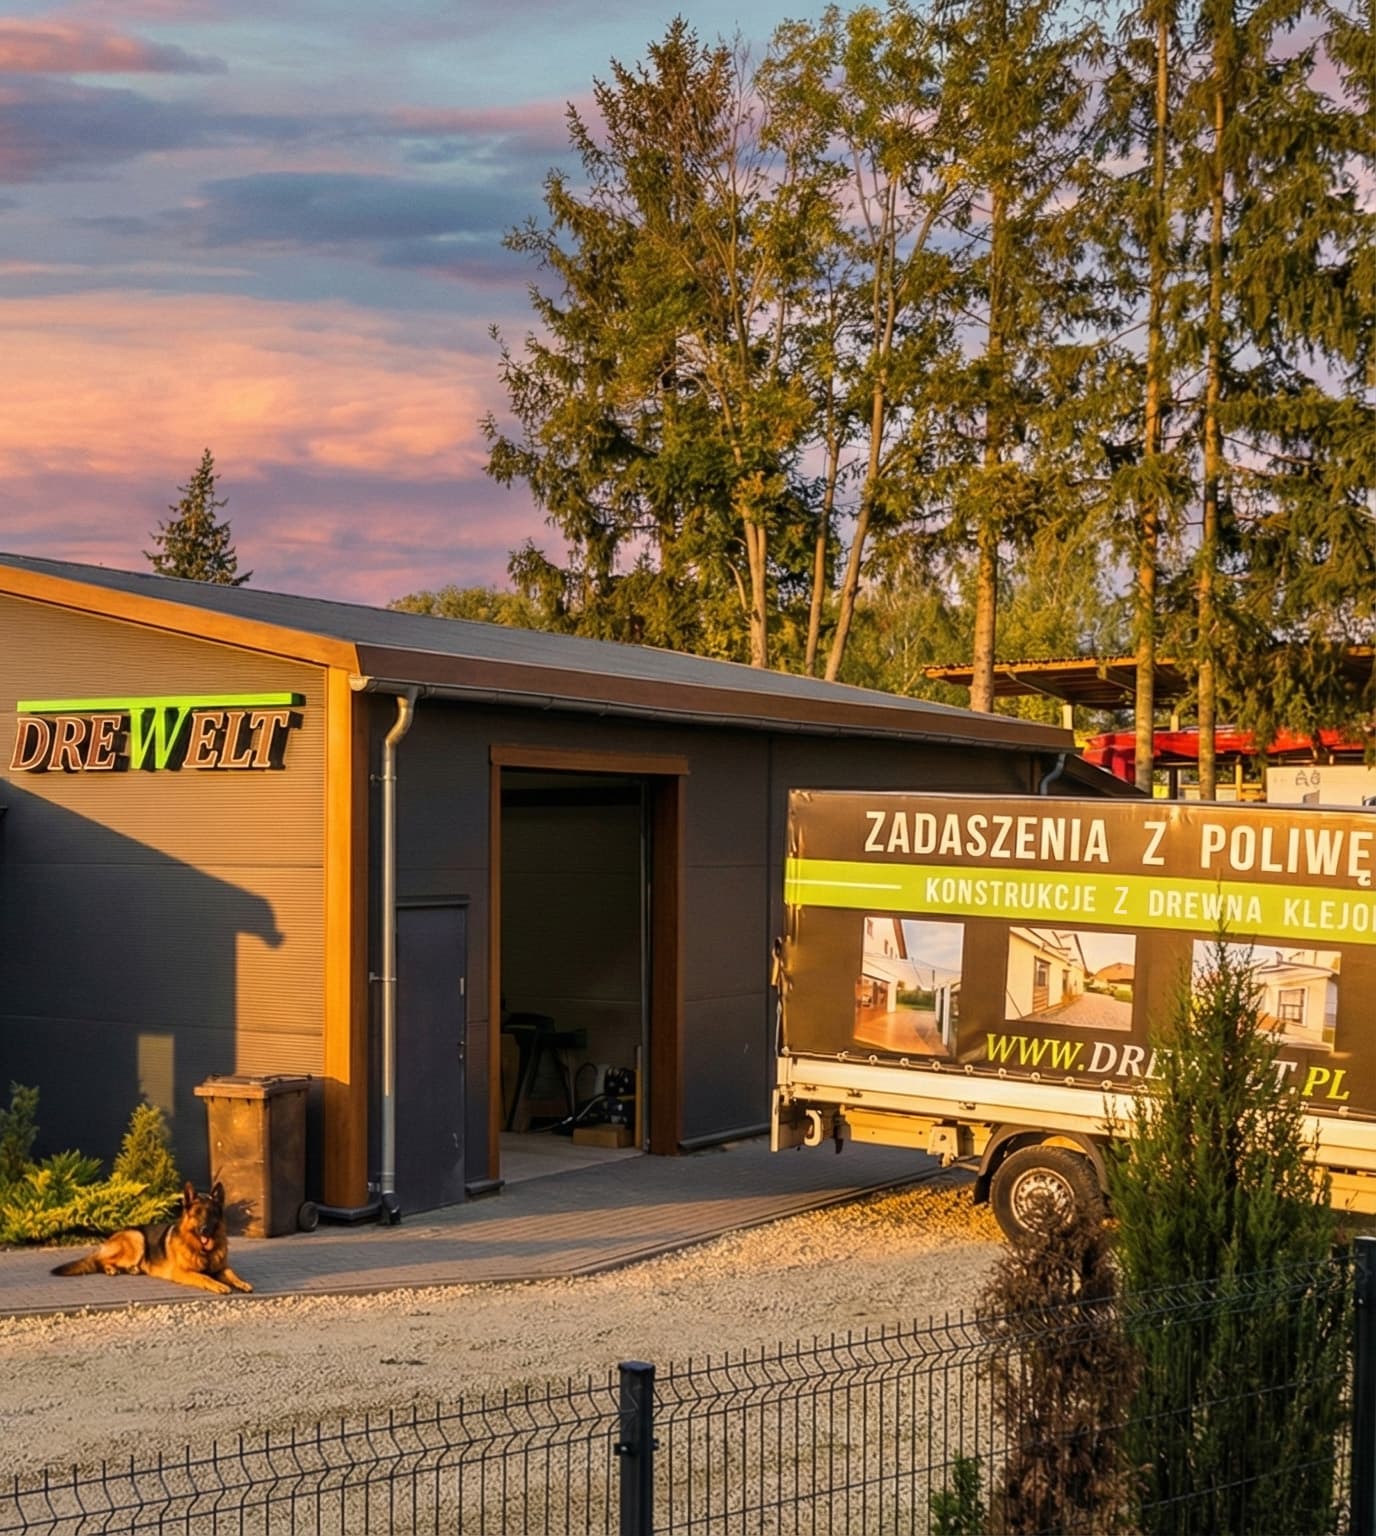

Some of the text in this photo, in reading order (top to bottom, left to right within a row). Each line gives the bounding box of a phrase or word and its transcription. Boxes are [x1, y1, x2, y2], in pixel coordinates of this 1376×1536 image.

[9, 704, 295, 771] DREWELT
[864, 811, 1374, 887] ZADASZENIA Z POLIWĘ
[925, 877, 1376, 933] KONSTRUKCJE Z DREWNA KLEJO
